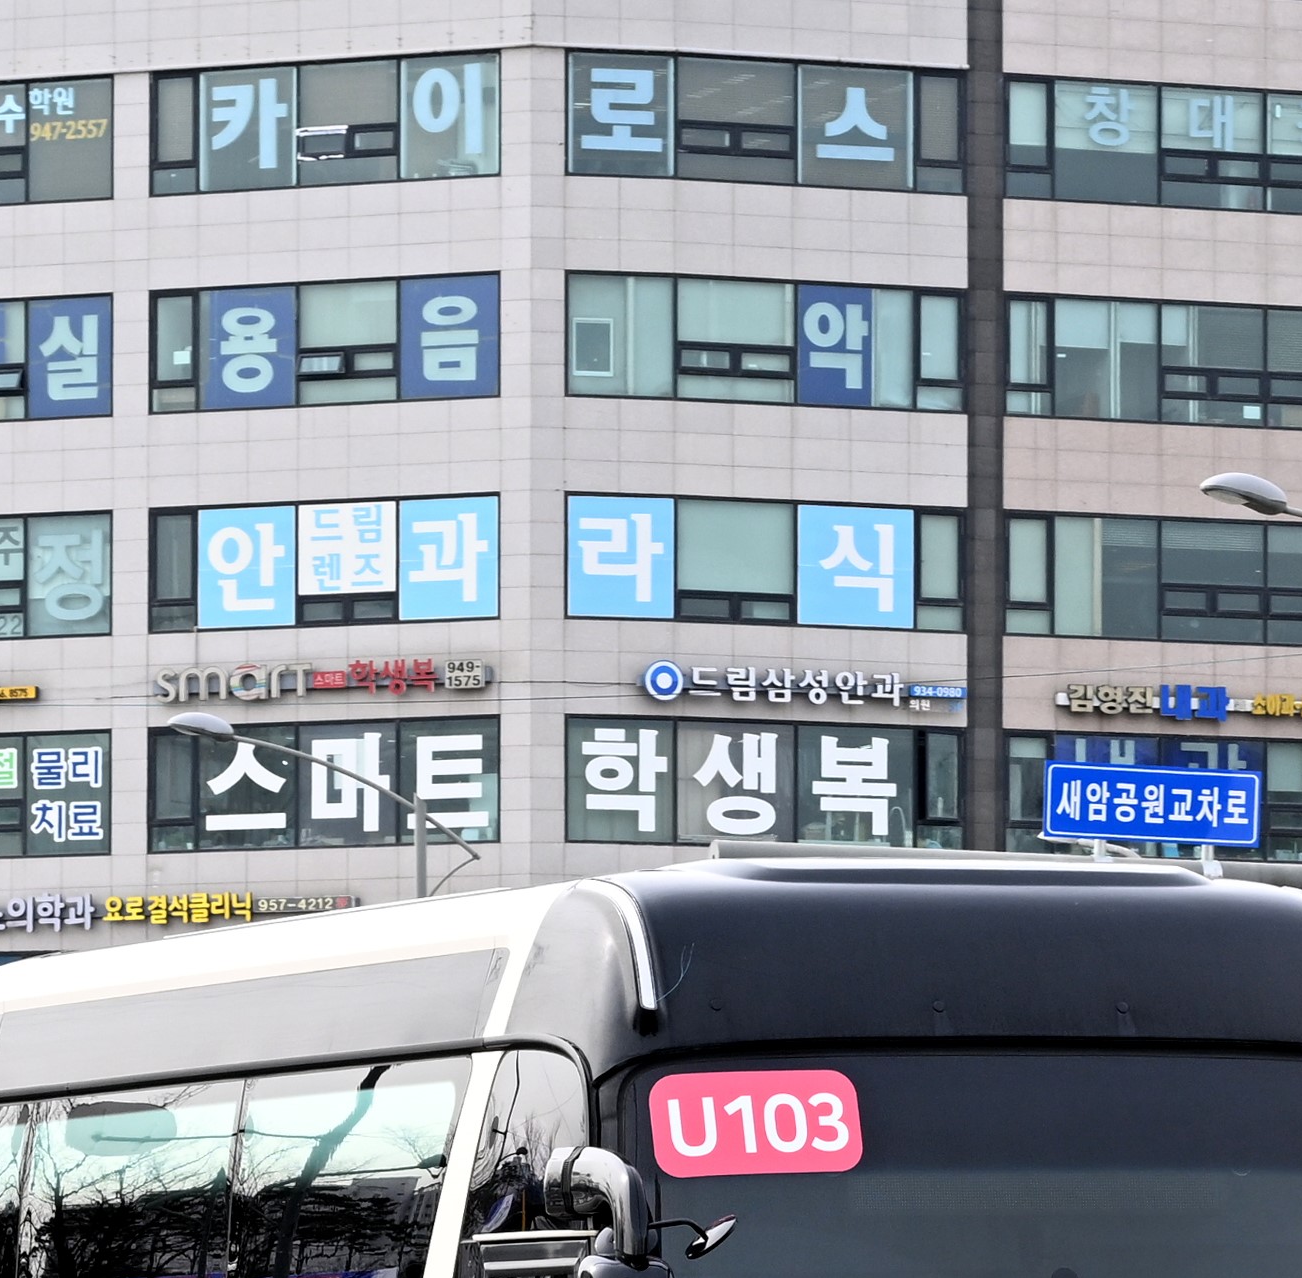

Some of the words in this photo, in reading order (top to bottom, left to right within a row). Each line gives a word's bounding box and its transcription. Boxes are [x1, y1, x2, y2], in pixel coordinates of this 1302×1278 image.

[29, 85, 76, 116] 학원
[30, 117, 108, 142] 947-2557
[309, 503, 384, 544] 드림
[310, 551, 385, 593] 렌즈
[348, 657, 439, 696] 학생복
[446, 660, 482, 674] 949-
[446, 674, 482, 688] 1575
[688, 666, 906, 708] 드림삼성안과
[913, 685, 964, 699] 934-0980
[30, 744, 104, 790] 물리
[203, 730, 491, 834] 스마트
[580, 727, 899, 837] 학생복
[30, 800, 105, 844] 치료
[1055, 779, 1250, 829] 새암공원교차로
[258, 895, 335, 914] 957-4212
[666, 1091, 850, 1158] U103
